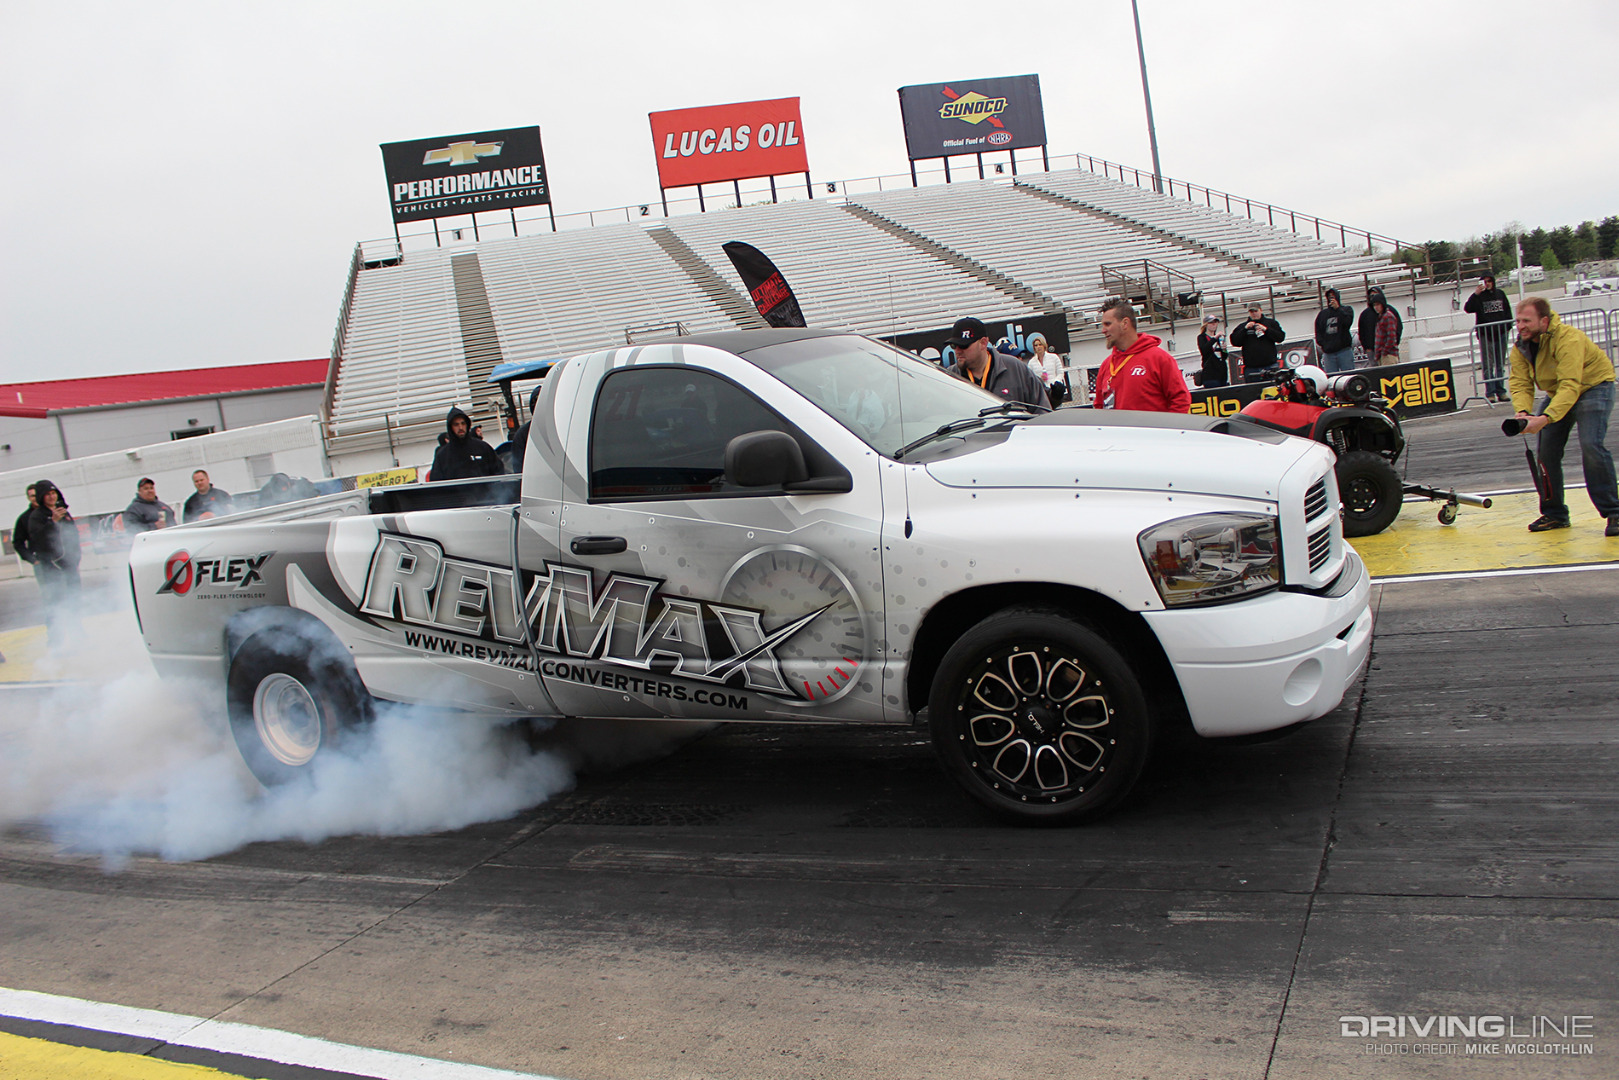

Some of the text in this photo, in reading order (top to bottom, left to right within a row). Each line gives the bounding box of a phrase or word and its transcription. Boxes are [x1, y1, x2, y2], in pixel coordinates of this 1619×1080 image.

[941, 99, 1005, 117] SUNOCO
[663, 120, 800, 158] LUCAS OIL
[943, 136, 986, 148] Official Fuel of
[988, 132, 1012, 145] NHRA
[996, 164, 1003, 174] 4
[393, 165, 543, 202] PERFORMANCE
[828, 183, 836, 193] 3
[396, 187, 545, 214] VEHICLES PARTS RACING
[640, 206, 649, 216] 2
[454, 230, 461, 240] 1
[1188, 396, 1241, 417] ello
[404, 630, 749, 712] WWW.REVMACONVERTERS.COM
